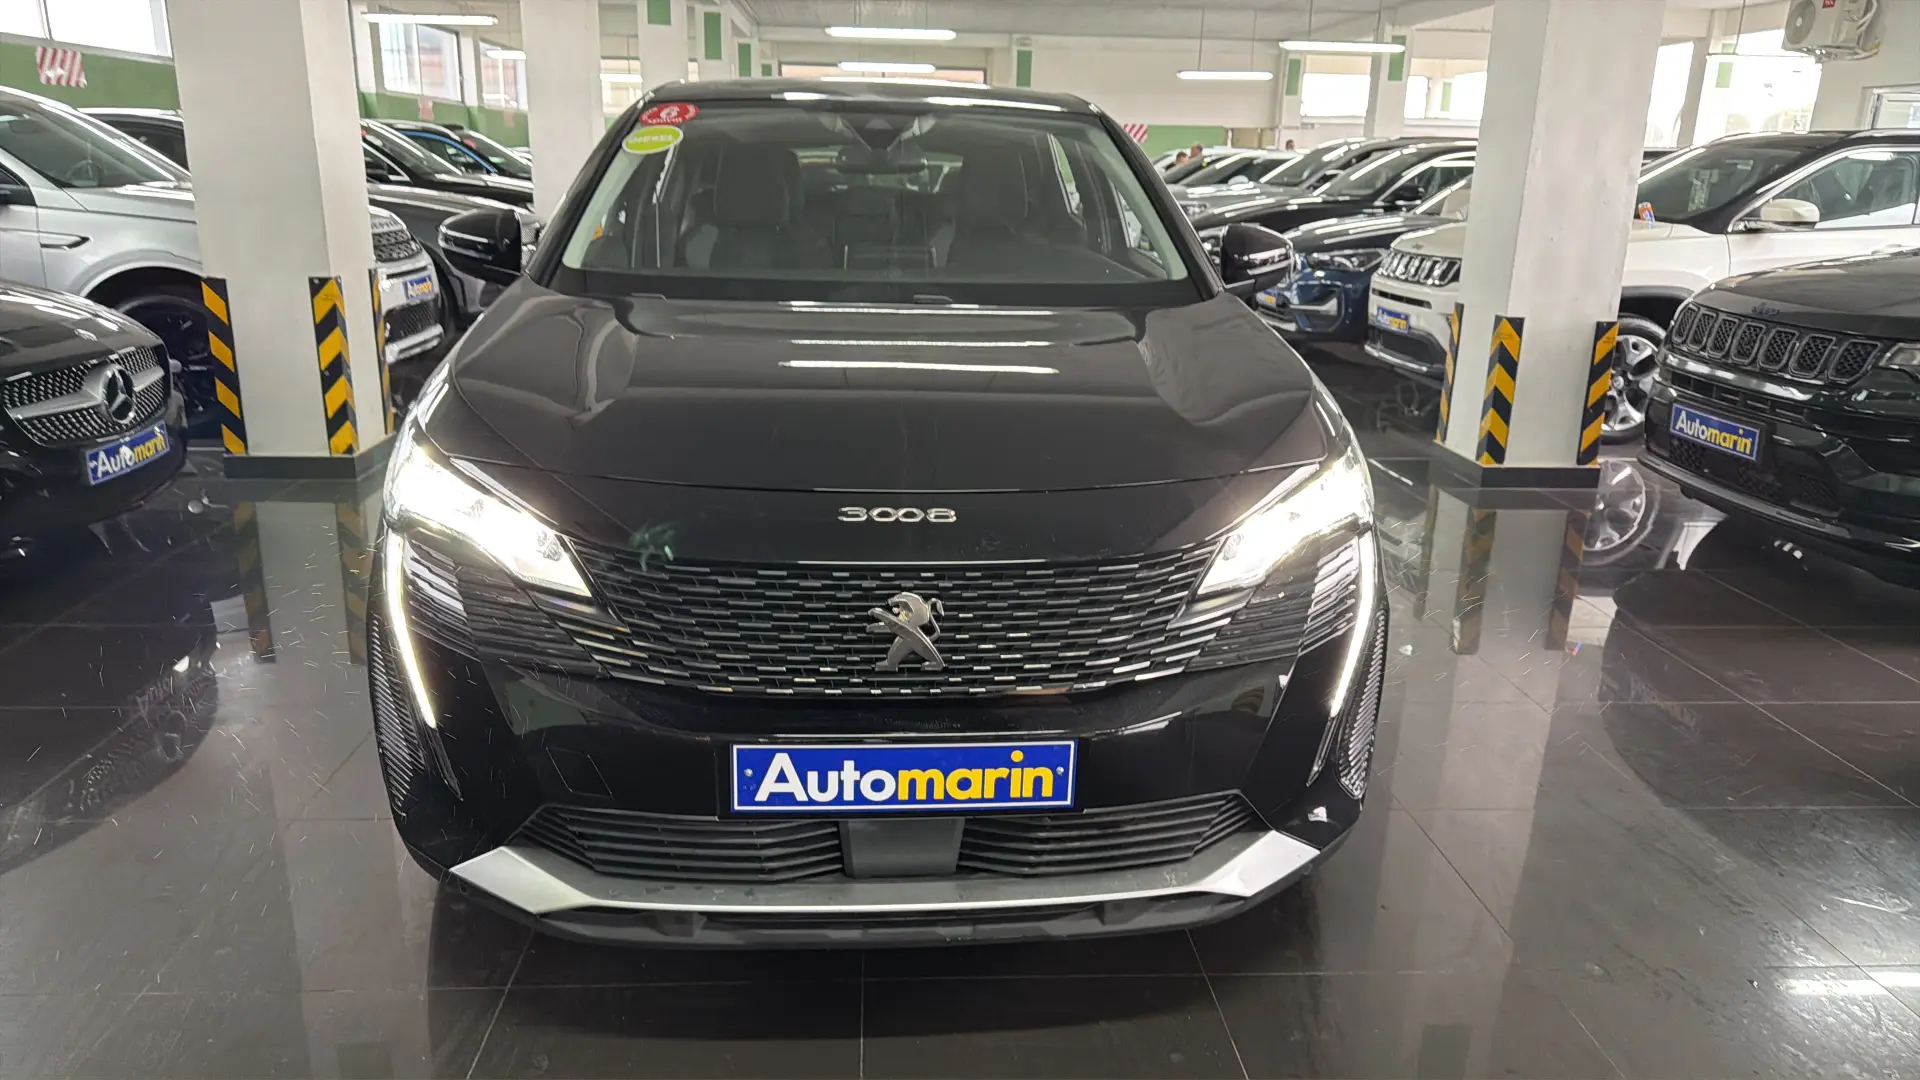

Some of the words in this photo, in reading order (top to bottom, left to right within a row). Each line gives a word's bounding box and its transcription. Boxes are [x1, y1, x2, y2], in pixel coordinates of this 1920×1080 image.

[97, 426, 166, 478] Automarin
[1675, 410, 1753, 455] Automarin
[837, 506, 957, 523] 3008
[754, 750, 1054, 802] Automarin
